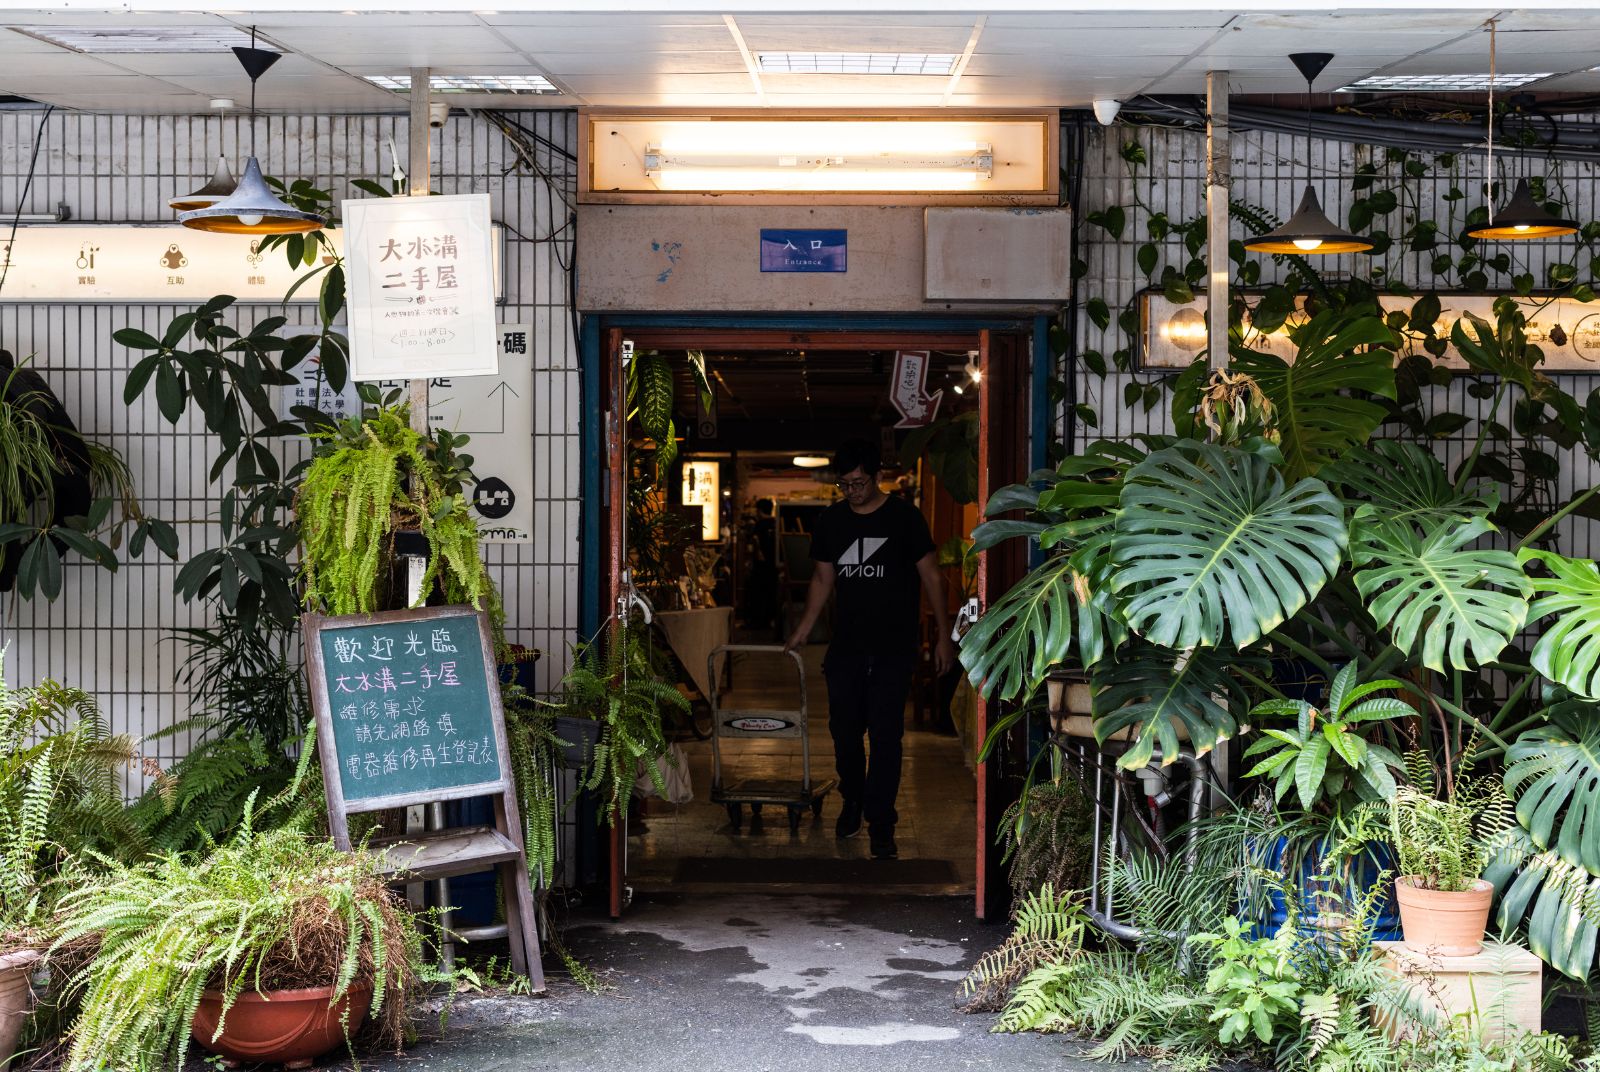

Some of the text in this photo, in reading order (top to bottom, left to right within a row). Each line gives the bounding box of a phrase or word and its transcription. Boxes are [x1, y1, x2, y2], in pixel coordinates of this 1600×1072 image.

[379, 234, 458, 262] 大水溝
[784, 240, 822, 250] 入口
[167, 275, 185, 285] 互助
[247, 275, 266, 285] 體驗
[382, 265, 458, 290] 二手屋
[498, 332, 526, 354] 碼
[838, 565, 884, 577] AVICII
[334, 628, 458, 663] 歡迎光臨
[335, 661, 461, 693] 大水溝二手屋
[340, 696, 426, 720] 維修需求
[346, 736, 495, 780] 電器維修再生登記表
